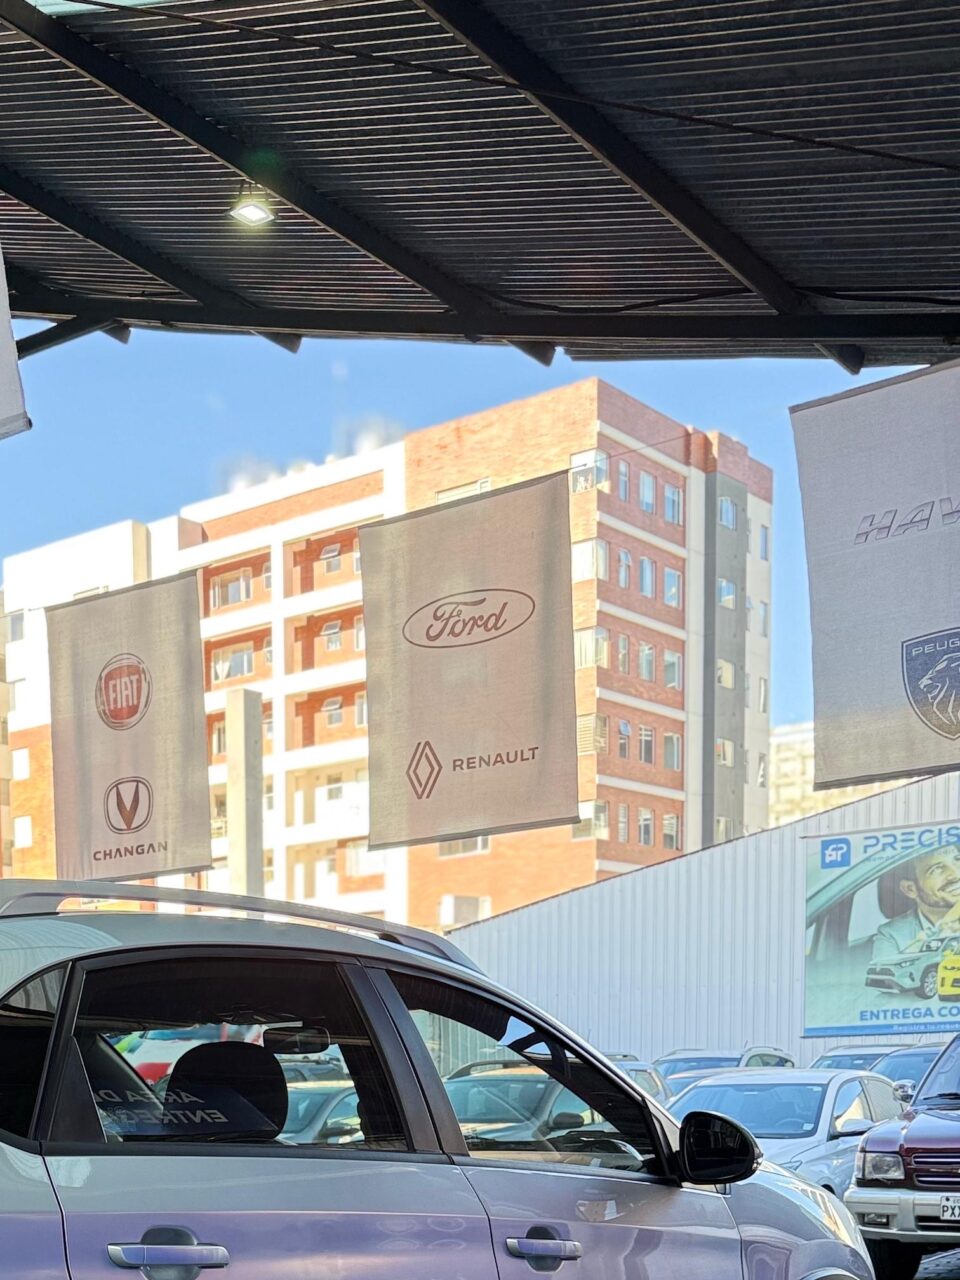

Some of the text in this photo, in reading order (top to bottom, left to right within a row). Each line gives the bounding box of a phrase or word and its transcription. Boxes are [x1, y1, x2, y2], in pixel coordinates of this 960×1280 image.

[426, 598, 508, 642] Ford
[108, 674, 140, 710] FIAT
[452, 746, 540, 773] RENAULT
[93, 841, 168, 862] CHANGAN
[863, 826, 960, 854] PRECIS
[860, 1008, 934, 1021] ENTREGA
